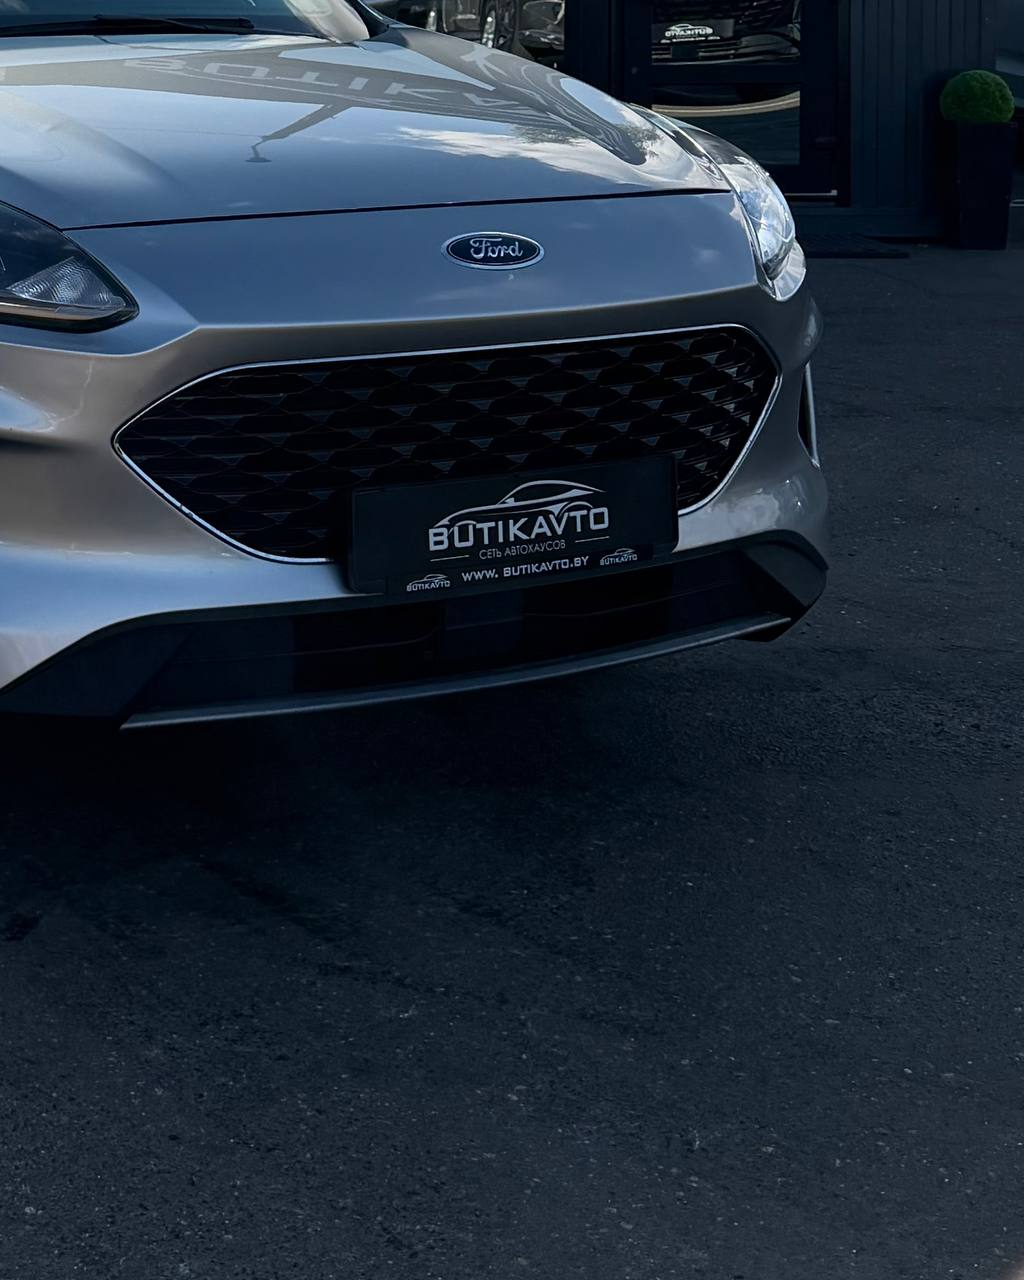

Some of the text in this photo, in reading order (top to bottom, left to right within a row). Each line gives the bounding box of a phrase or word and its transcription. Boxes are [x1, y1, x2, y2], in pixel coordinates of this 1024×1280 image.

[469, 237, 523, 260] Ford
[428, 507, 610, 552] BUTIKAVTO
[479, 540, 566, 561] СЕТЬ АВТОХАУСОВ
